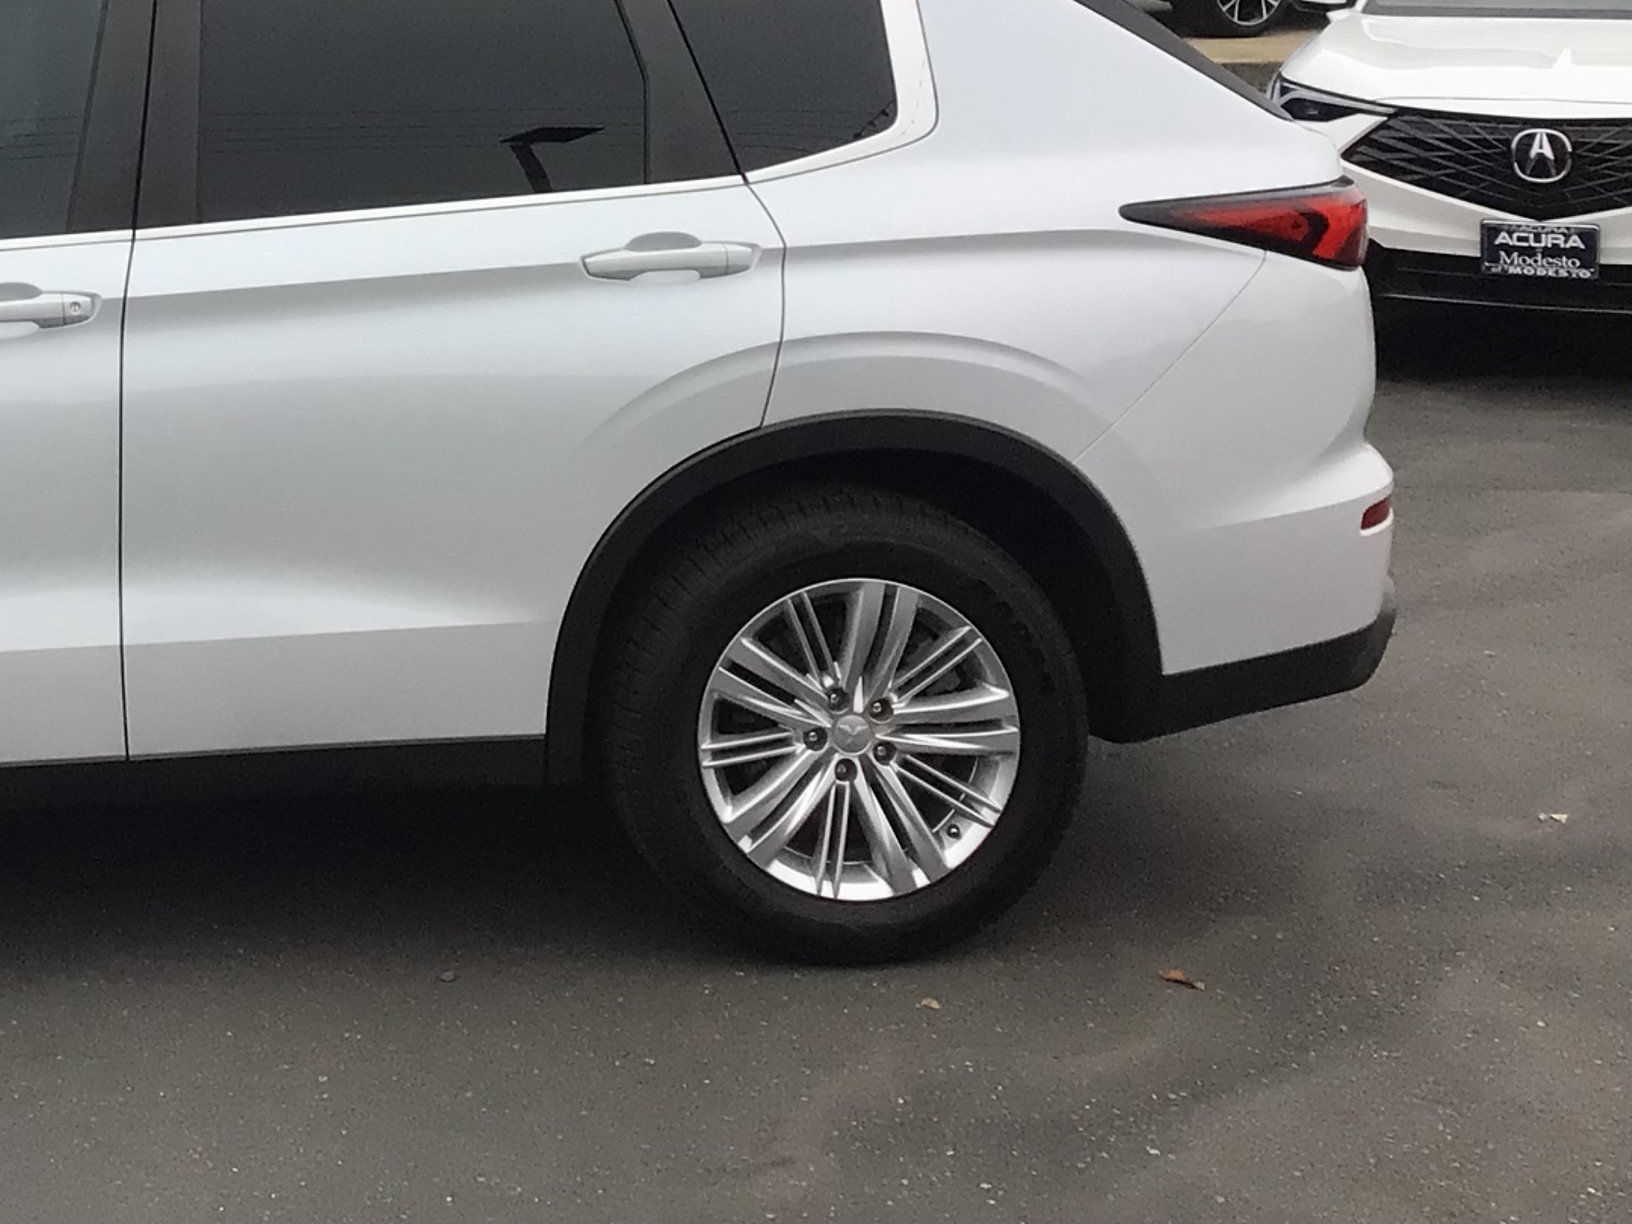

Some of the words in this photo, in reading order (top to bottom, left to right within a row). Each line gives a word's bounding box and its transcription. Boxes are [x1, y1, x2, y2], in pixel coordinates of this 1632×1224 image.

[1494, 231, 1585, 249] ACURA
[1499, 250, 1581, 268] Modesto
[1508, 265, 1591, 278] MODESTO
